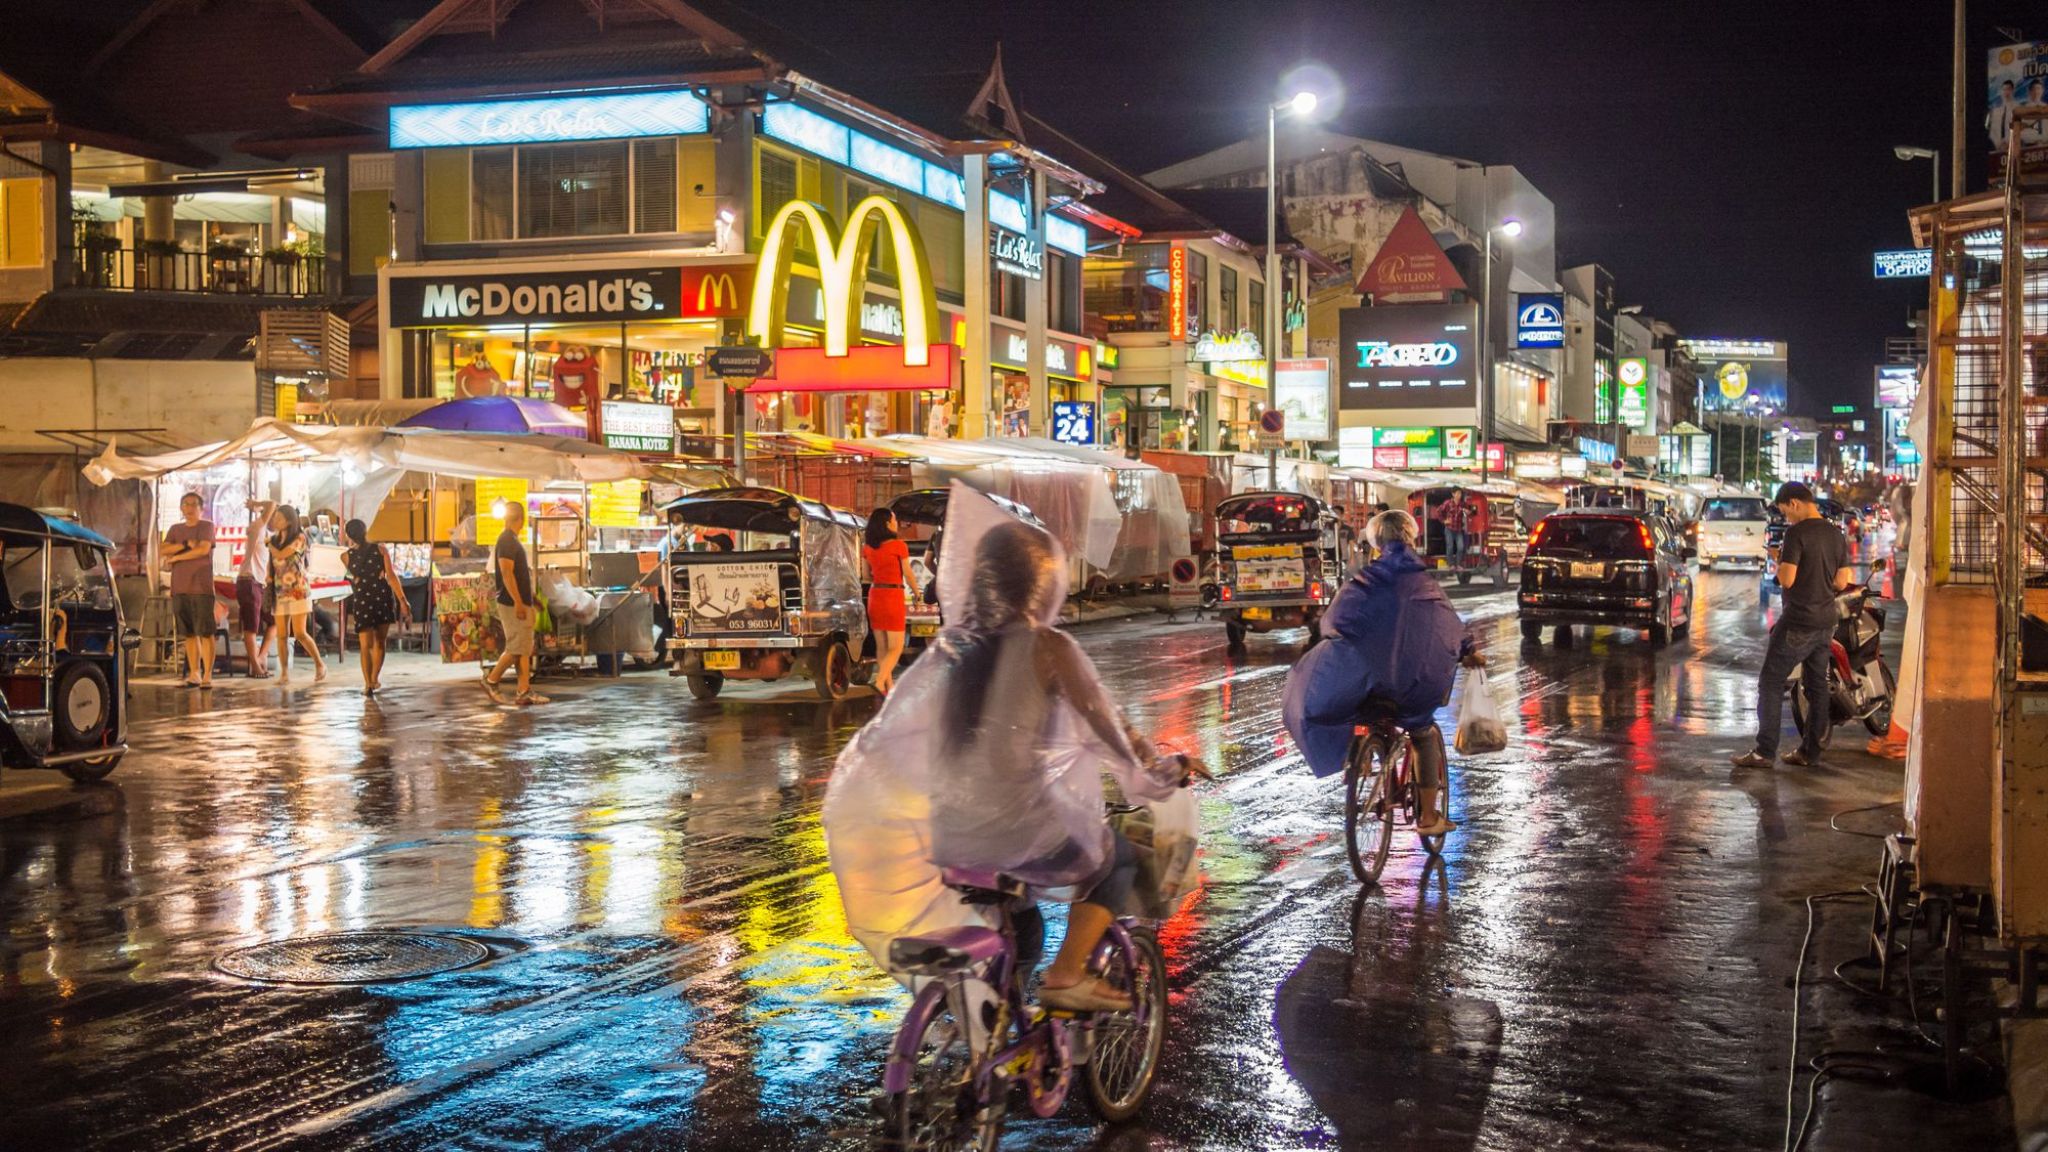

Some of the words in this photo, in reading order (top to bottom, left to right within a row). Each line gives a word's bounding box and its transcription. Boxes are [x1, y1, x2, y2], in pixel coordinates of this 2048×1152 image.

[480, 110, 536, 137] Let's
[540, 107, 611, 135] Relax
[996, 230, 1019, 261] Let's
[1018, 236, 1042, 270] Relax
[1173, 249, 1183, 337] COCKTAILS
[1056, 418, 1089, 441] 24
[608, 436, 641, 450] BANANA
[642, 438, 669, 451] ROTEE
[728, 620, 745, 629] 053
